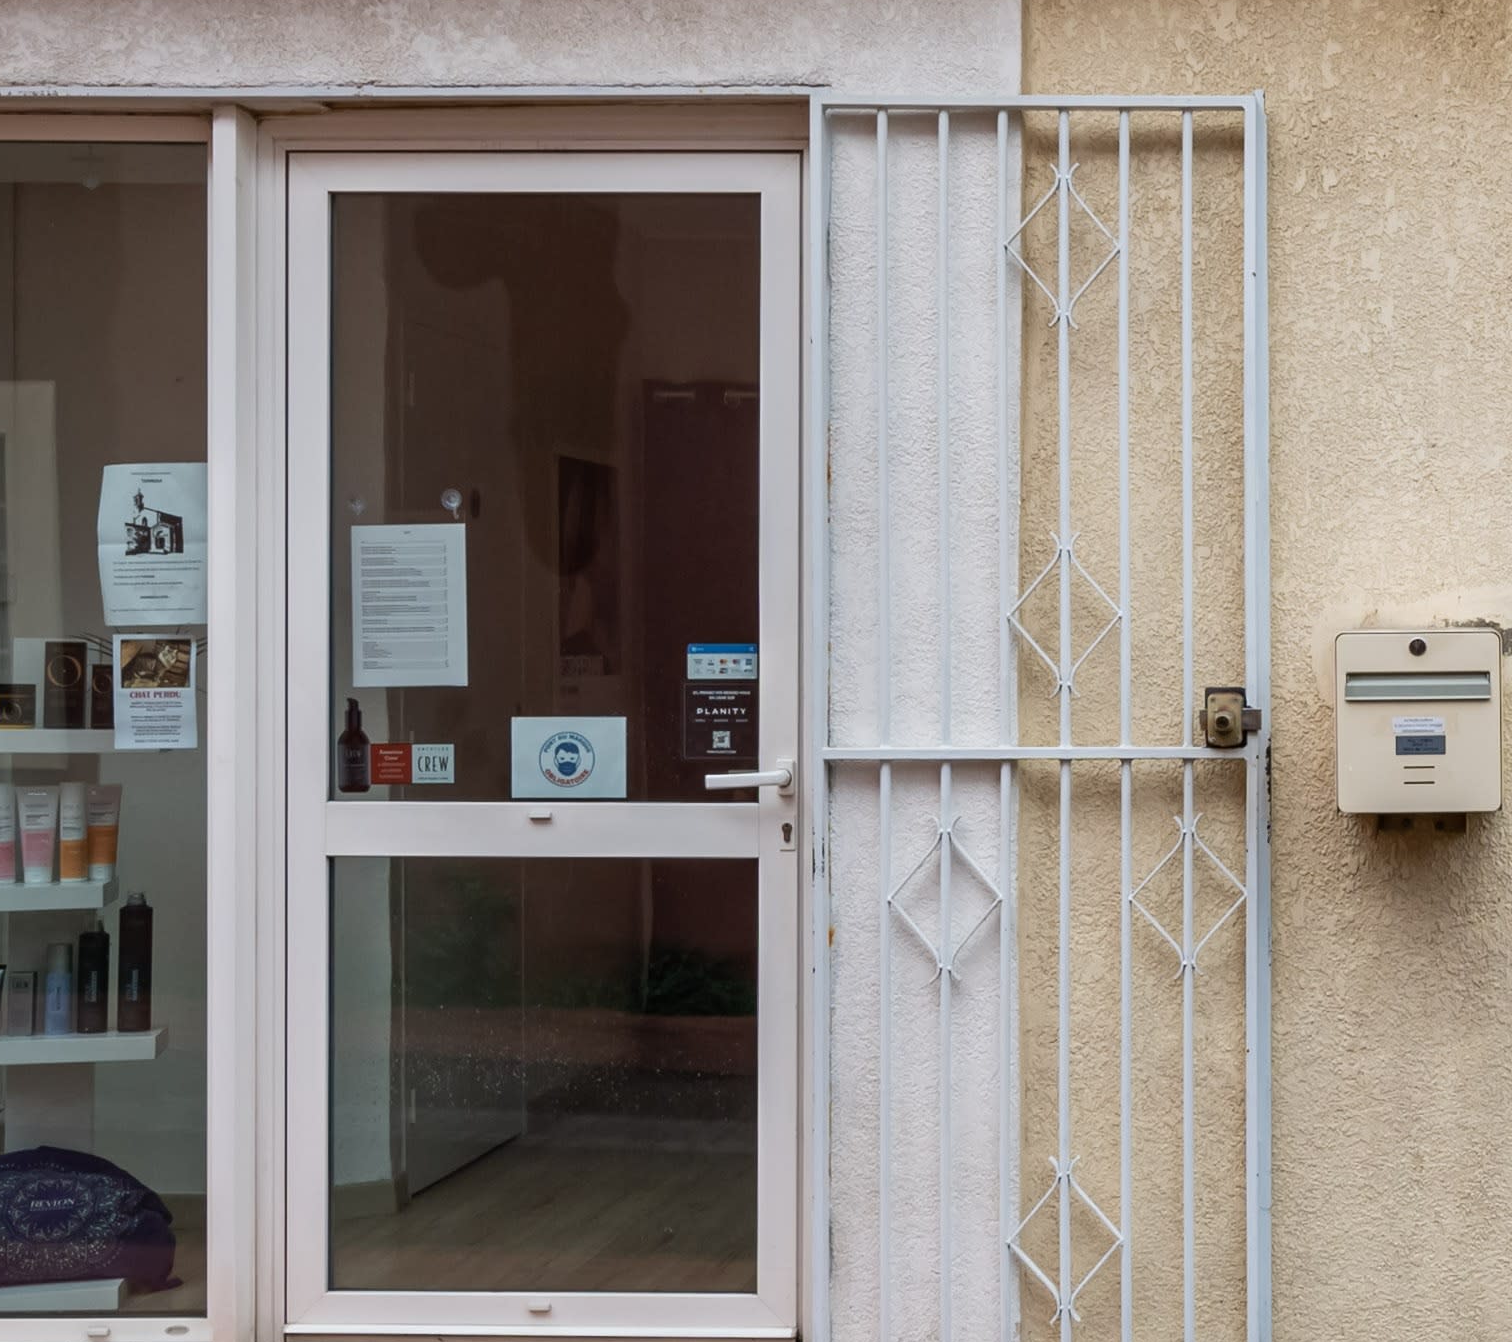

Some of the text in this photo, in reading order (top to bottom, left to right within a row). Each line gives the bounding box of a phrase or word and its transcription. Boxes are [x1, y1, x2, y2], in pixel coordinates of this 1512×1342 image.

[696, 707, 747, 715] PLANITY
[417, 755, 449, 773] CREW
[30, 1198, 75, 1208] REVLON
